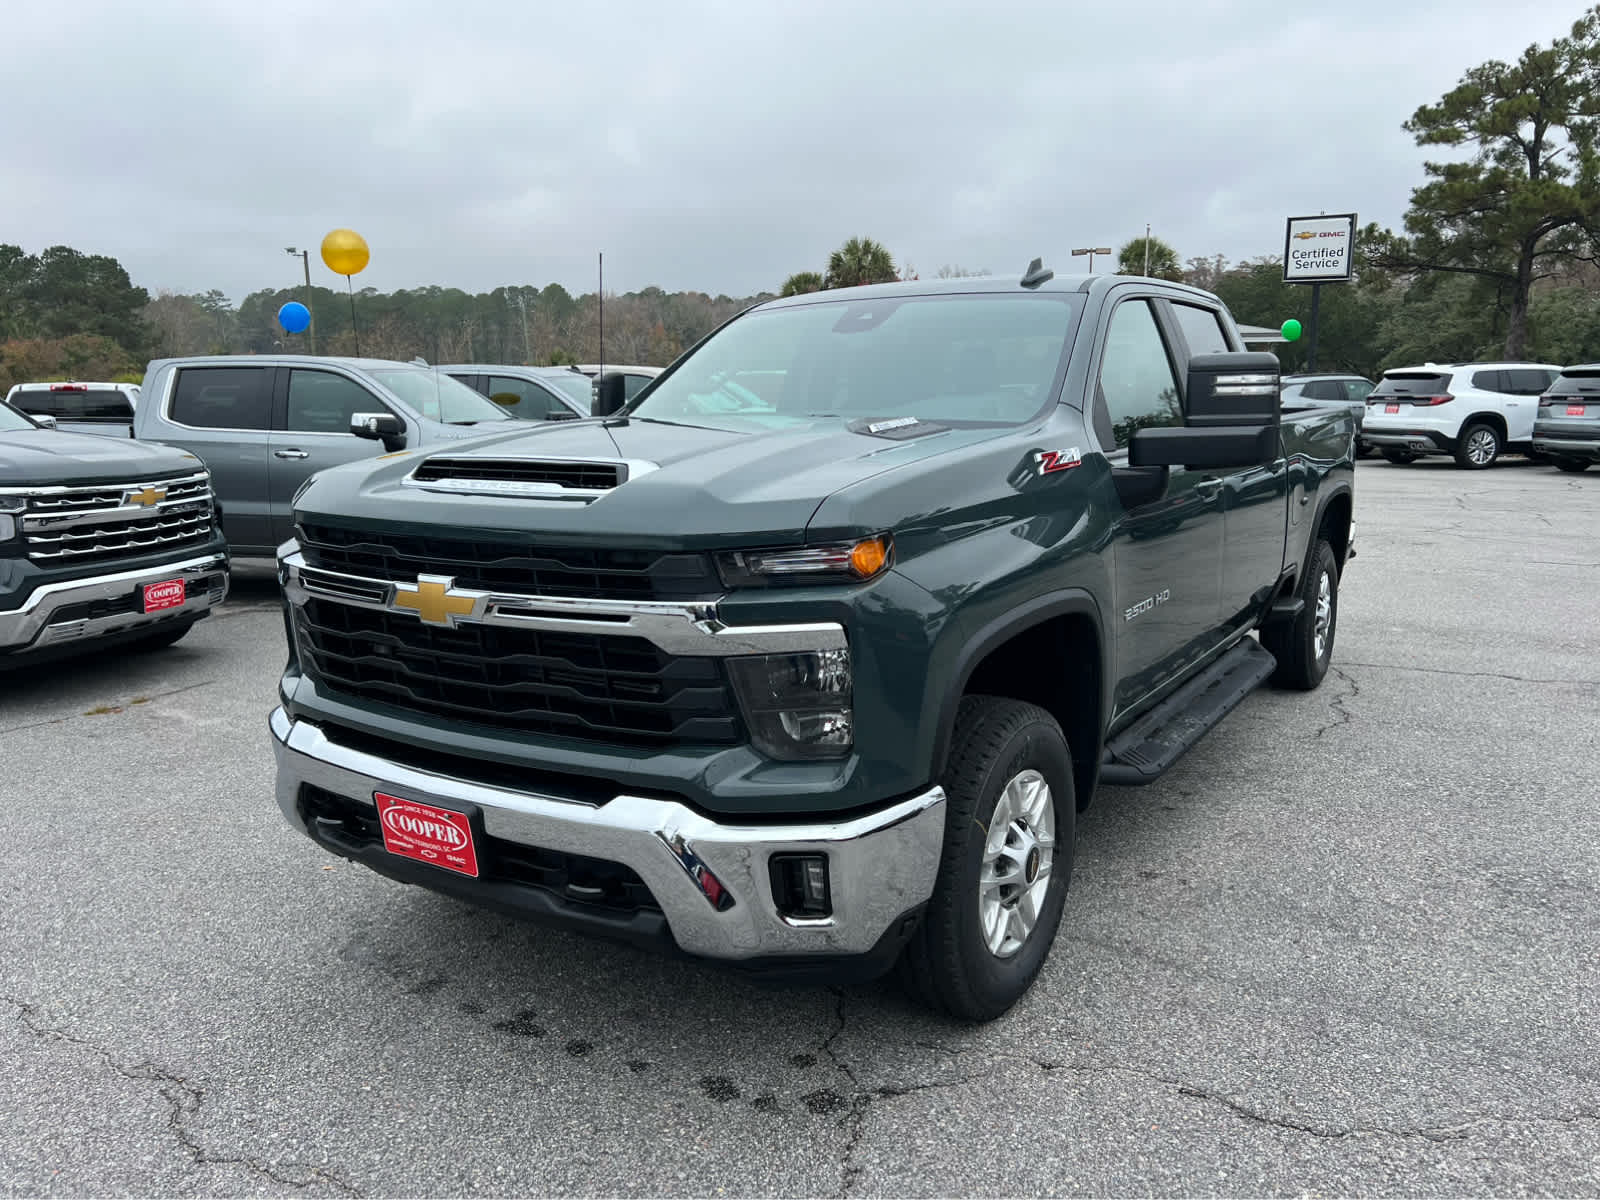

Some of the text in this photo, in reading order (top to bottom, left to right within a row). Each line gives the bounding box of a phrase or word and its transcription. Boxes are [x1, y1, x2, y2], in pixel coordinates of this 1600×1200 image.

[1292, 247, 1344, 260] Certified
[1295, 258, 1340, 270] Service
[148, 586, 180, 599] COOPER
[1124, 589, 1170, 621] 2500 HD
[388, 812, 461, 845] COOPER
[446, 854, 466, 865] GMC
